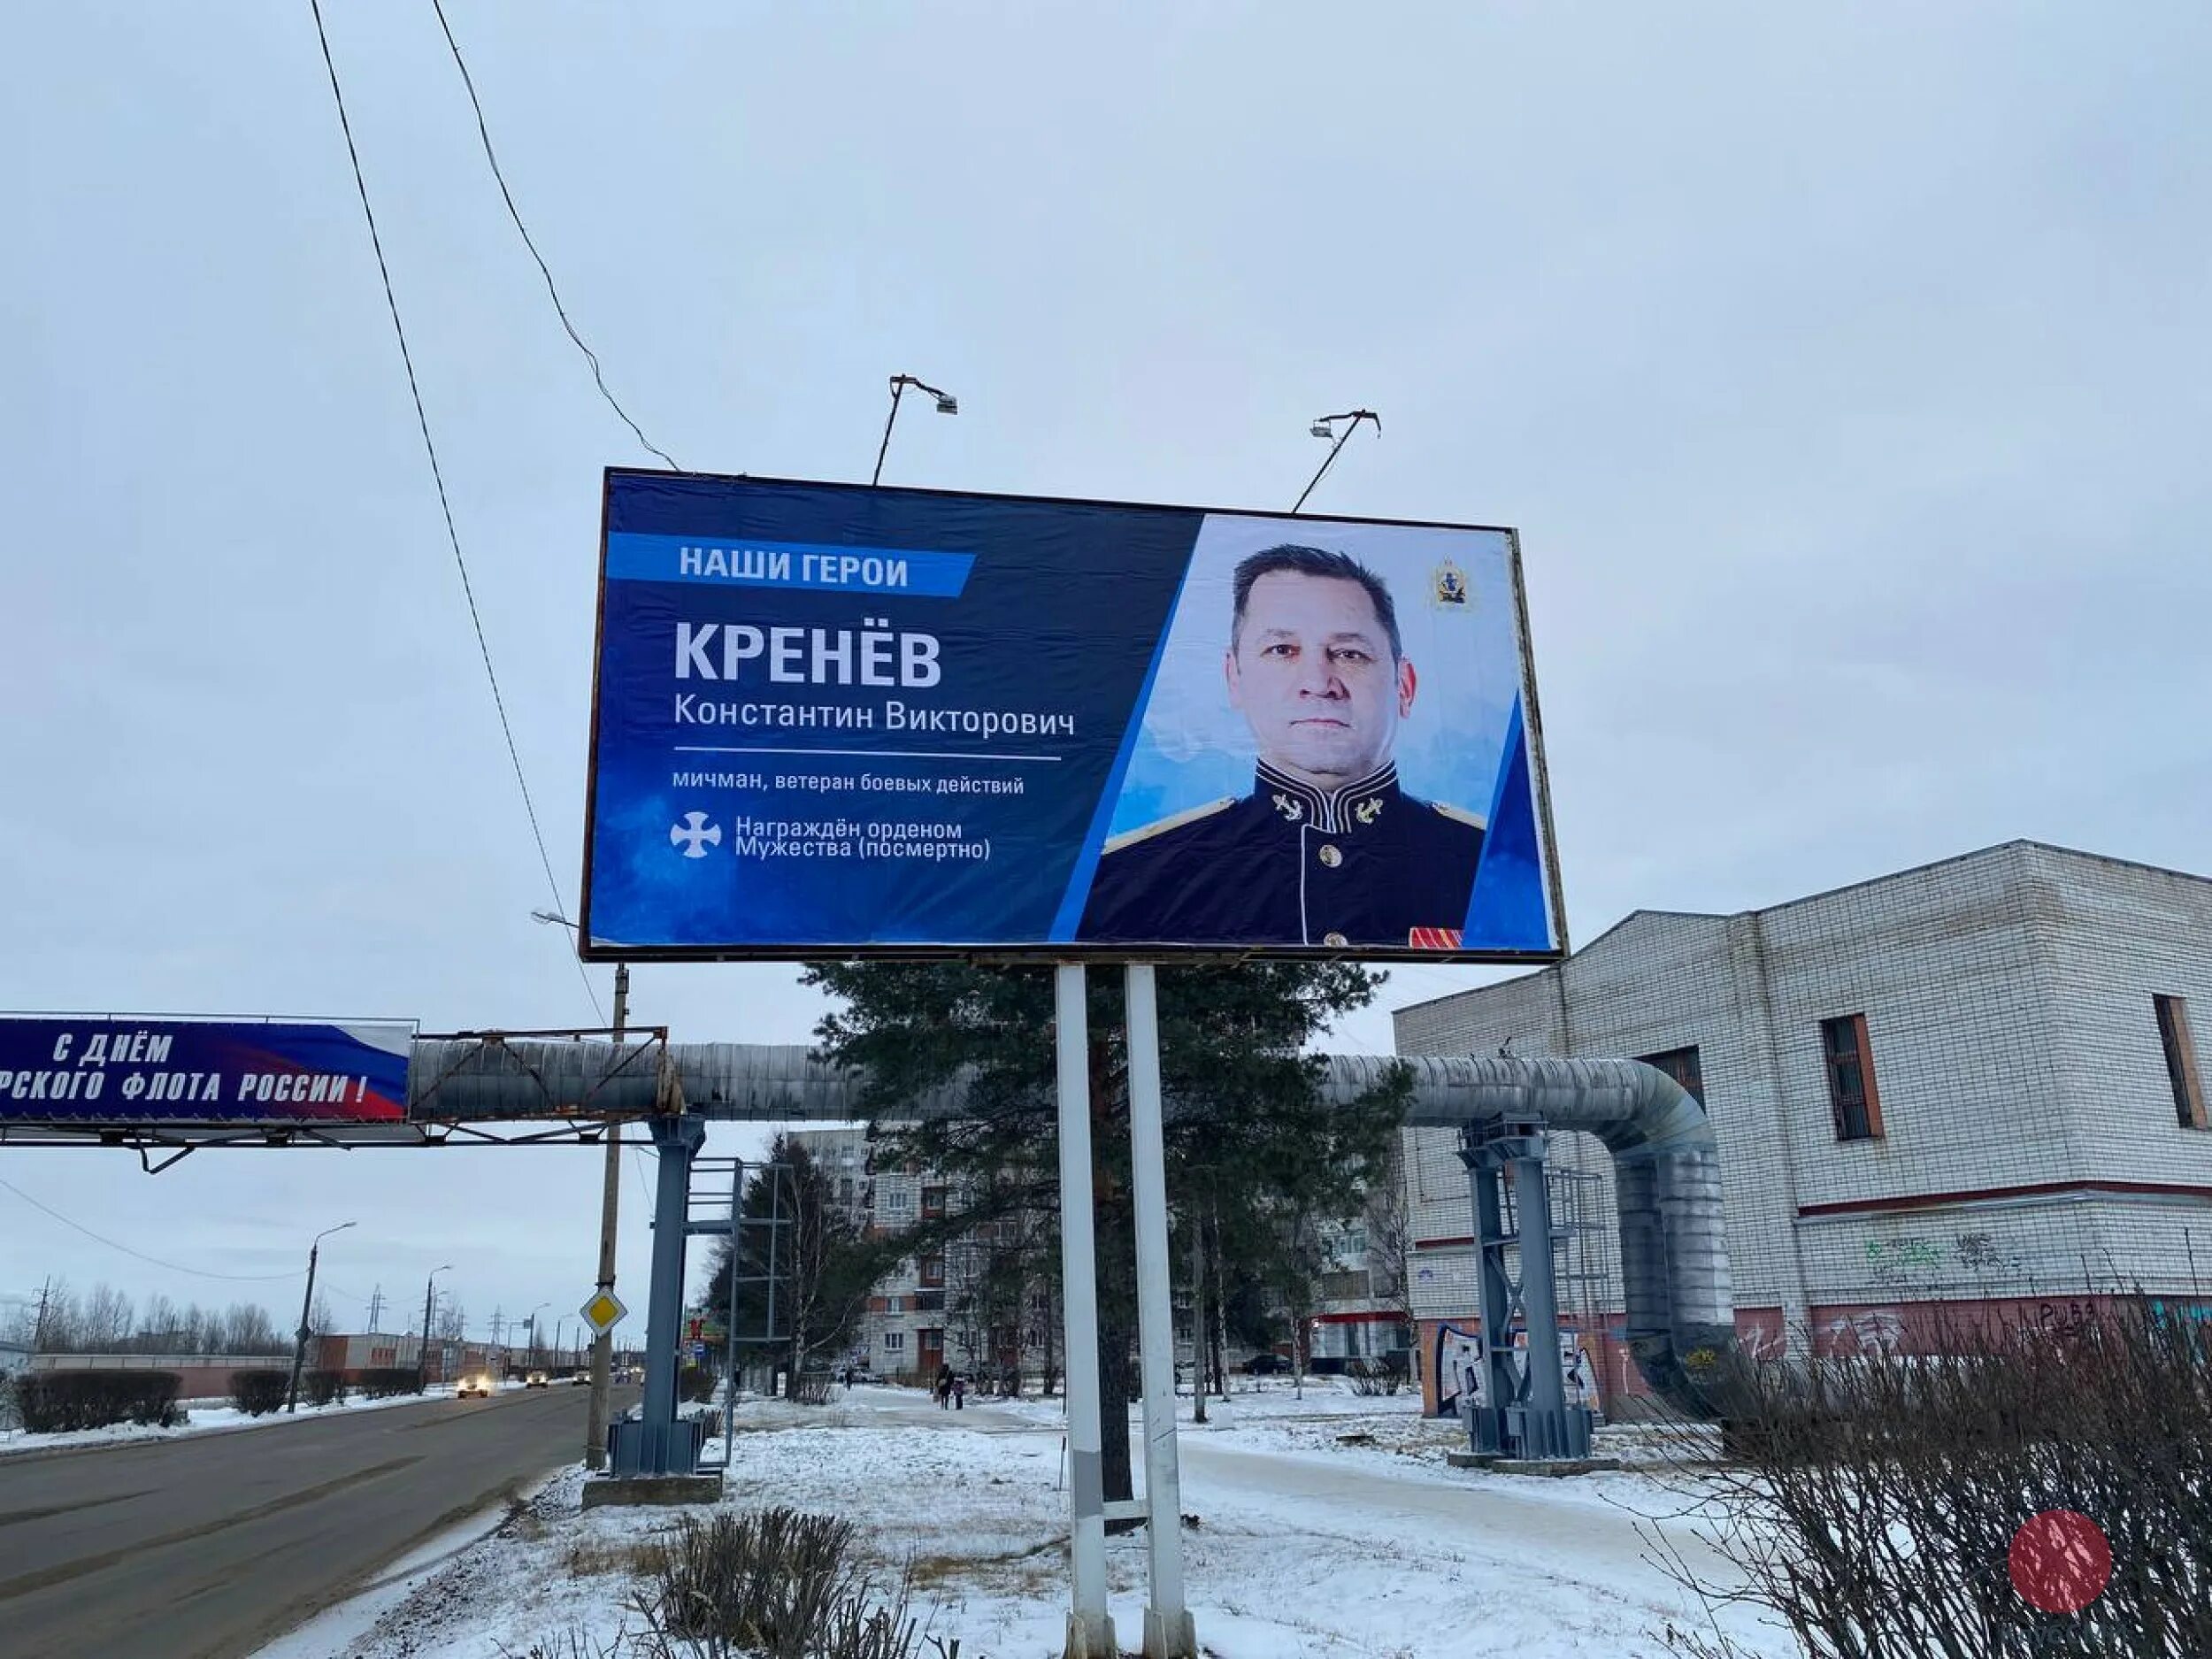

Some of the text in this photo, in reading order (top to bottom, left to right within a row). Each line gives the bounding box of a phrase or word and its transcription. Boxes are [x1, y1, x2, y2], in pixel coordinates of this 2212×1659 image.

[680, 547, 908, 587] НАШИ ГЕРОИ
[675, 618, 941, 687] КРЕНЁВ
[675, 693, 1074, 739] Константин Викторович
[672, 772, 1024, 795] мичман, ветеран боевых действий
[735, 815, 962, 841] Награждён орденом
[735, 835, 991, 862] Мужества (посмертно)
[52, 1030, 173, 1067] С ДНЁМ
[122, 1071, 220, 1102] ФЛОТА
[237, 1073, 349, 1103] РОССИИ
